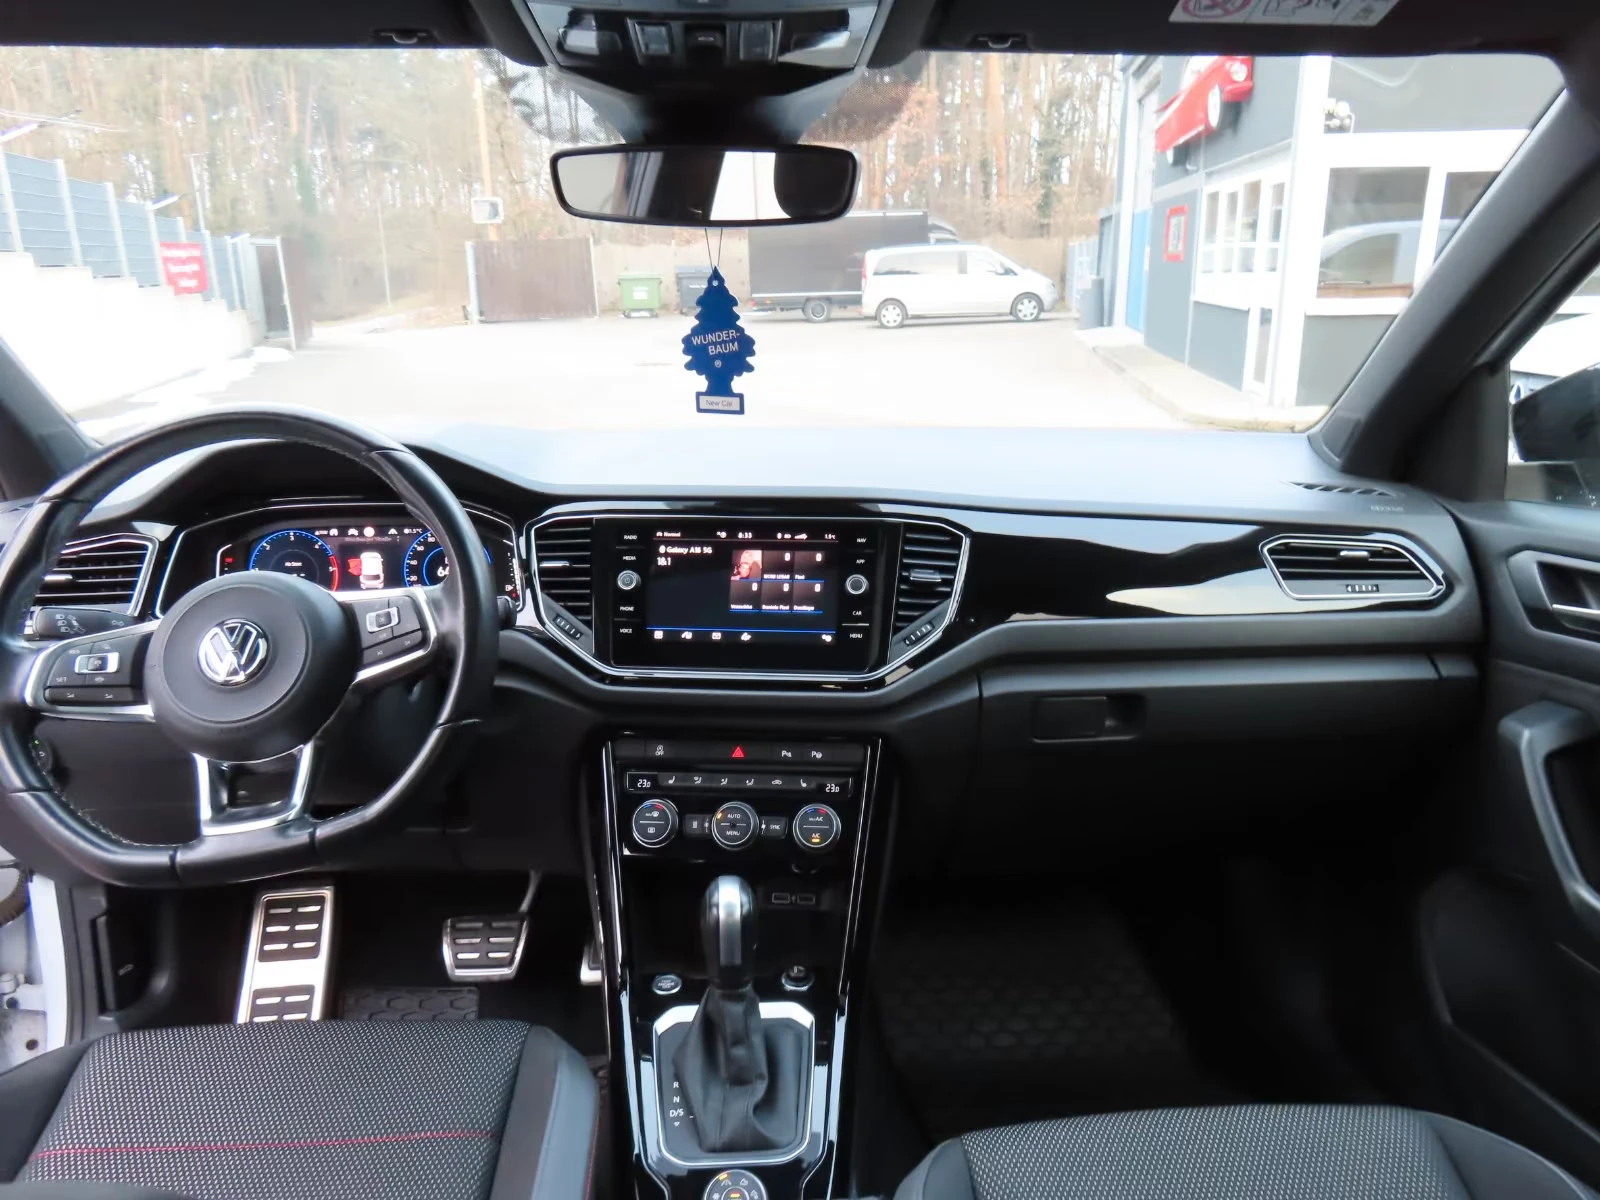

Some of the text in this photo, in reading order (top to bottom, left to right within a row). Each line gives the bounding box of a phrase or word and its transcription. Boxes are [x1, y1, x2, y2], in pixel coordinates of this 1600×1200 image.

[692, 329, 740, 346] WUNDER-
[708, 341, 739, 355] BAUM
[705, 399, 721, 407] New
[672, 1081, 680, 1089] R
[673, 1095, 680, 1104] N
[669, 1108, 684, 1118] D/S
